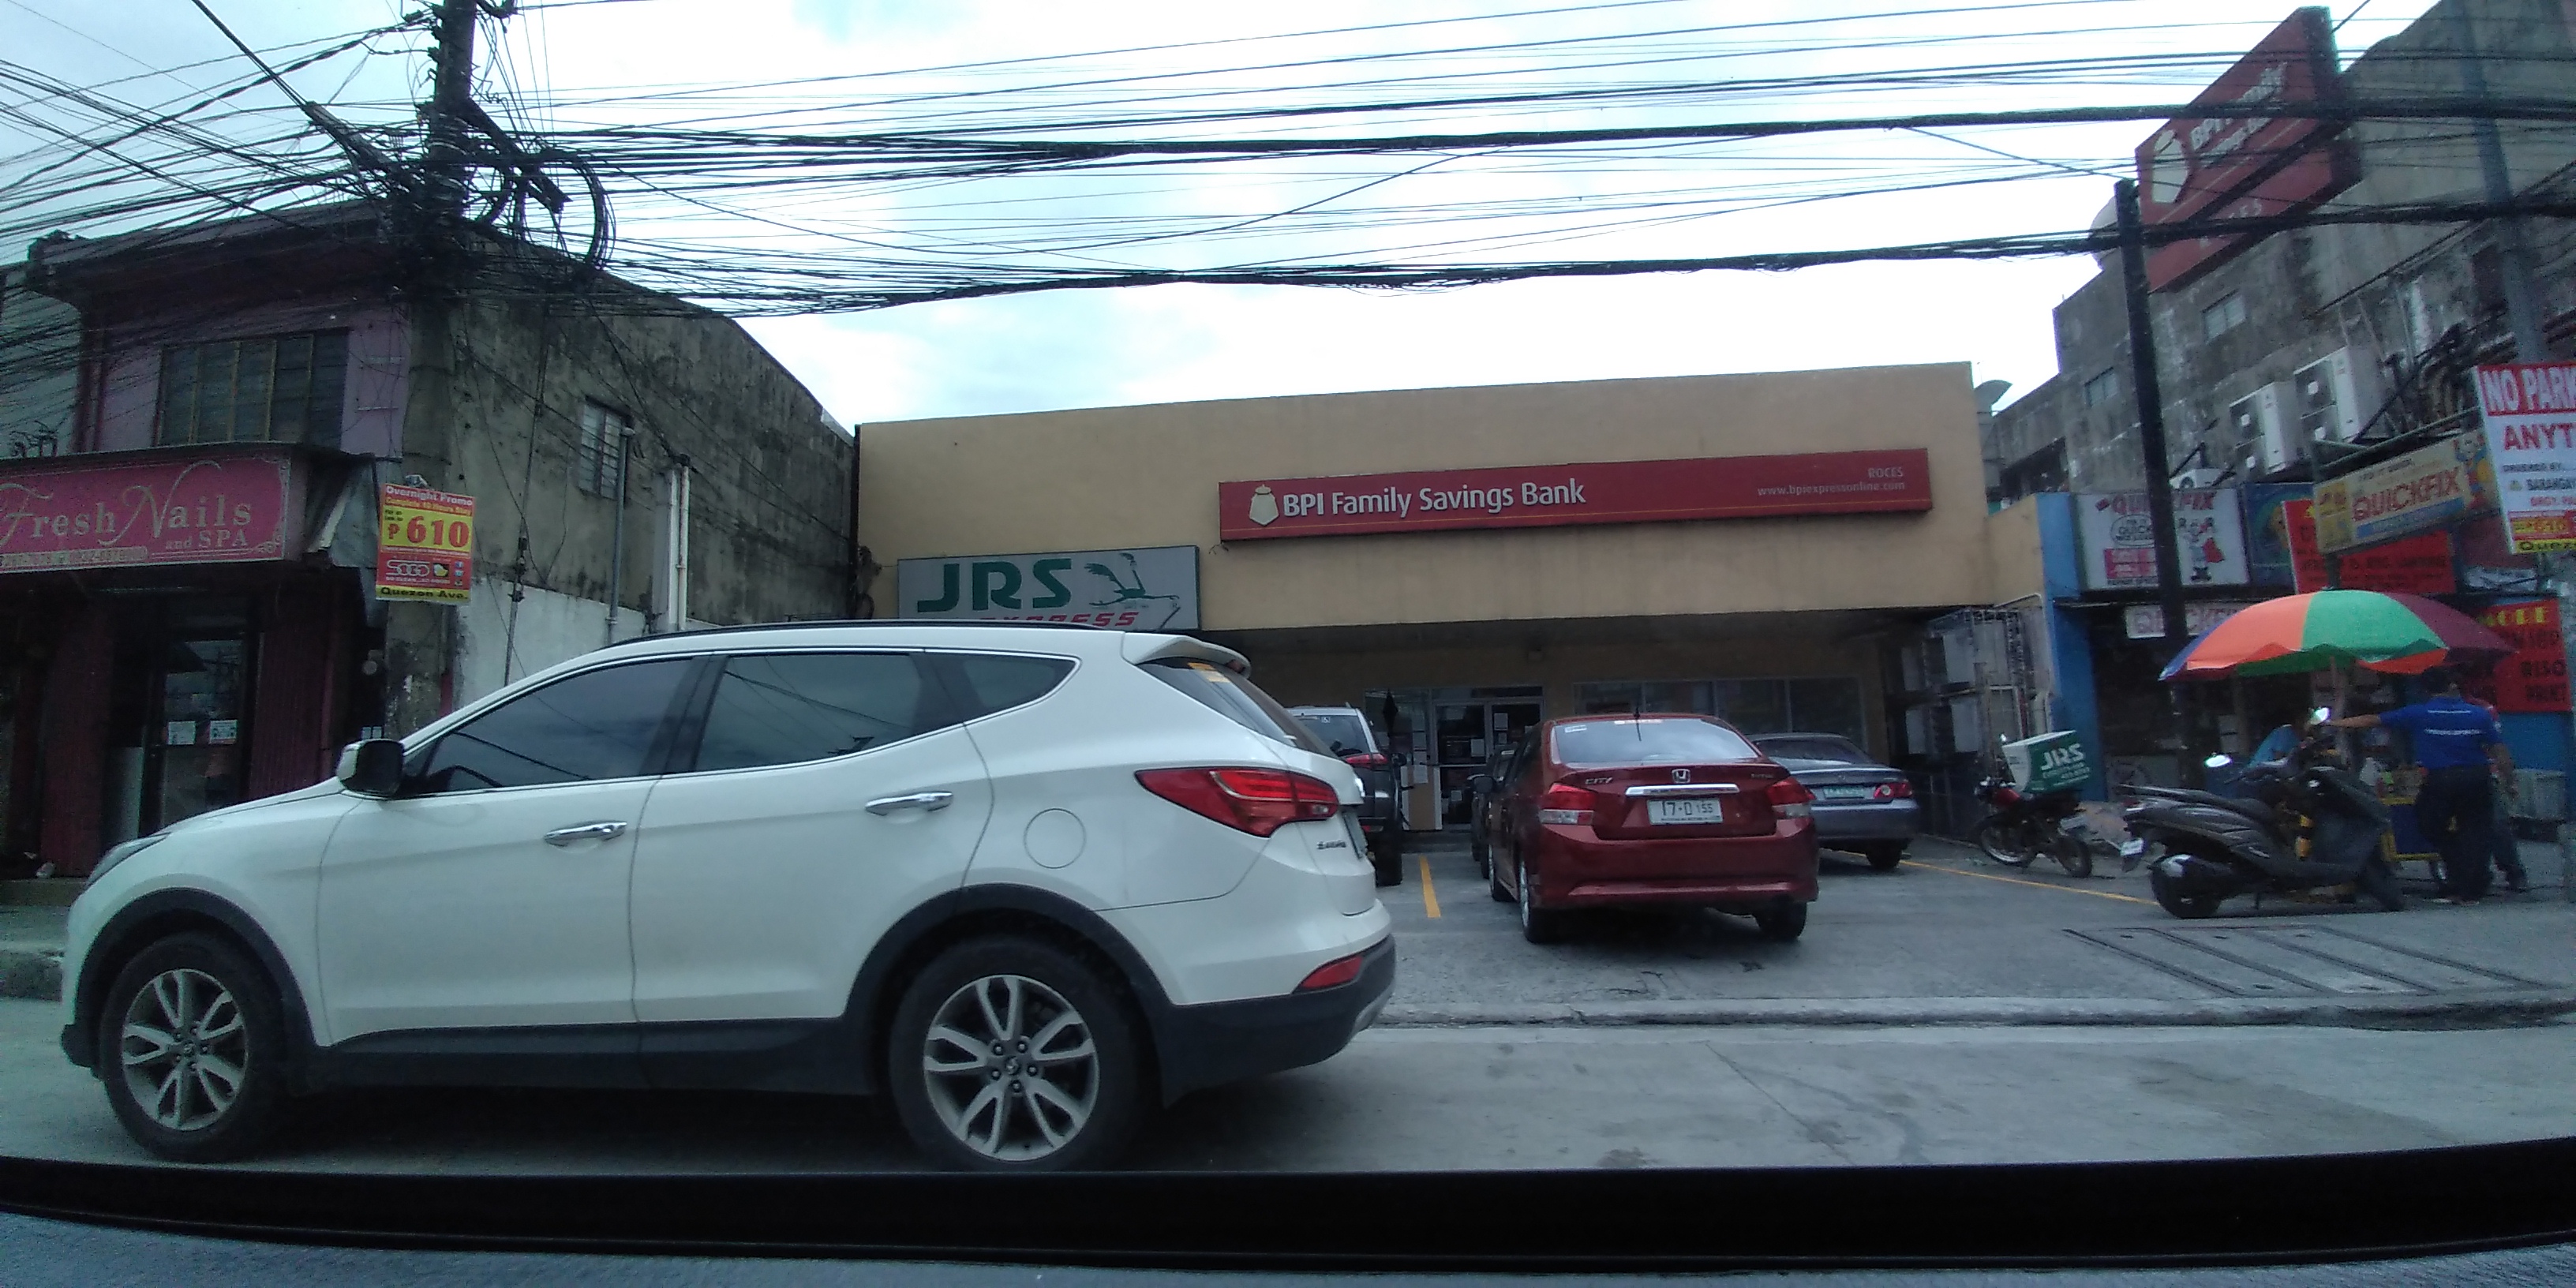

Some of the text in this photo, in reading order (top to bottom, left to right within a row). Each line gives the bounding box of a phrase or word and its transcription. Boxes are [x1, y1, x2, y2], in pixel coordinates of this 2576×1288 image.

[2482, 369, 2518, 412] NO
[0, 459, 253, 545] Fresh Nails
[386, 485, 473, 506] Overnight Promo
[1283, 477, 1586, 518] BPI Family Savings Bank
[165, 529, 249, 549] and SPA
[406, 515, 470, 548] 610
[380, 586, 469, 600] Quezon Ave.
[917, 558, 1072, 612] JRS
[2041, 743, 2084, 770] JRS
[1585, 777, 1613, 786] CITY
